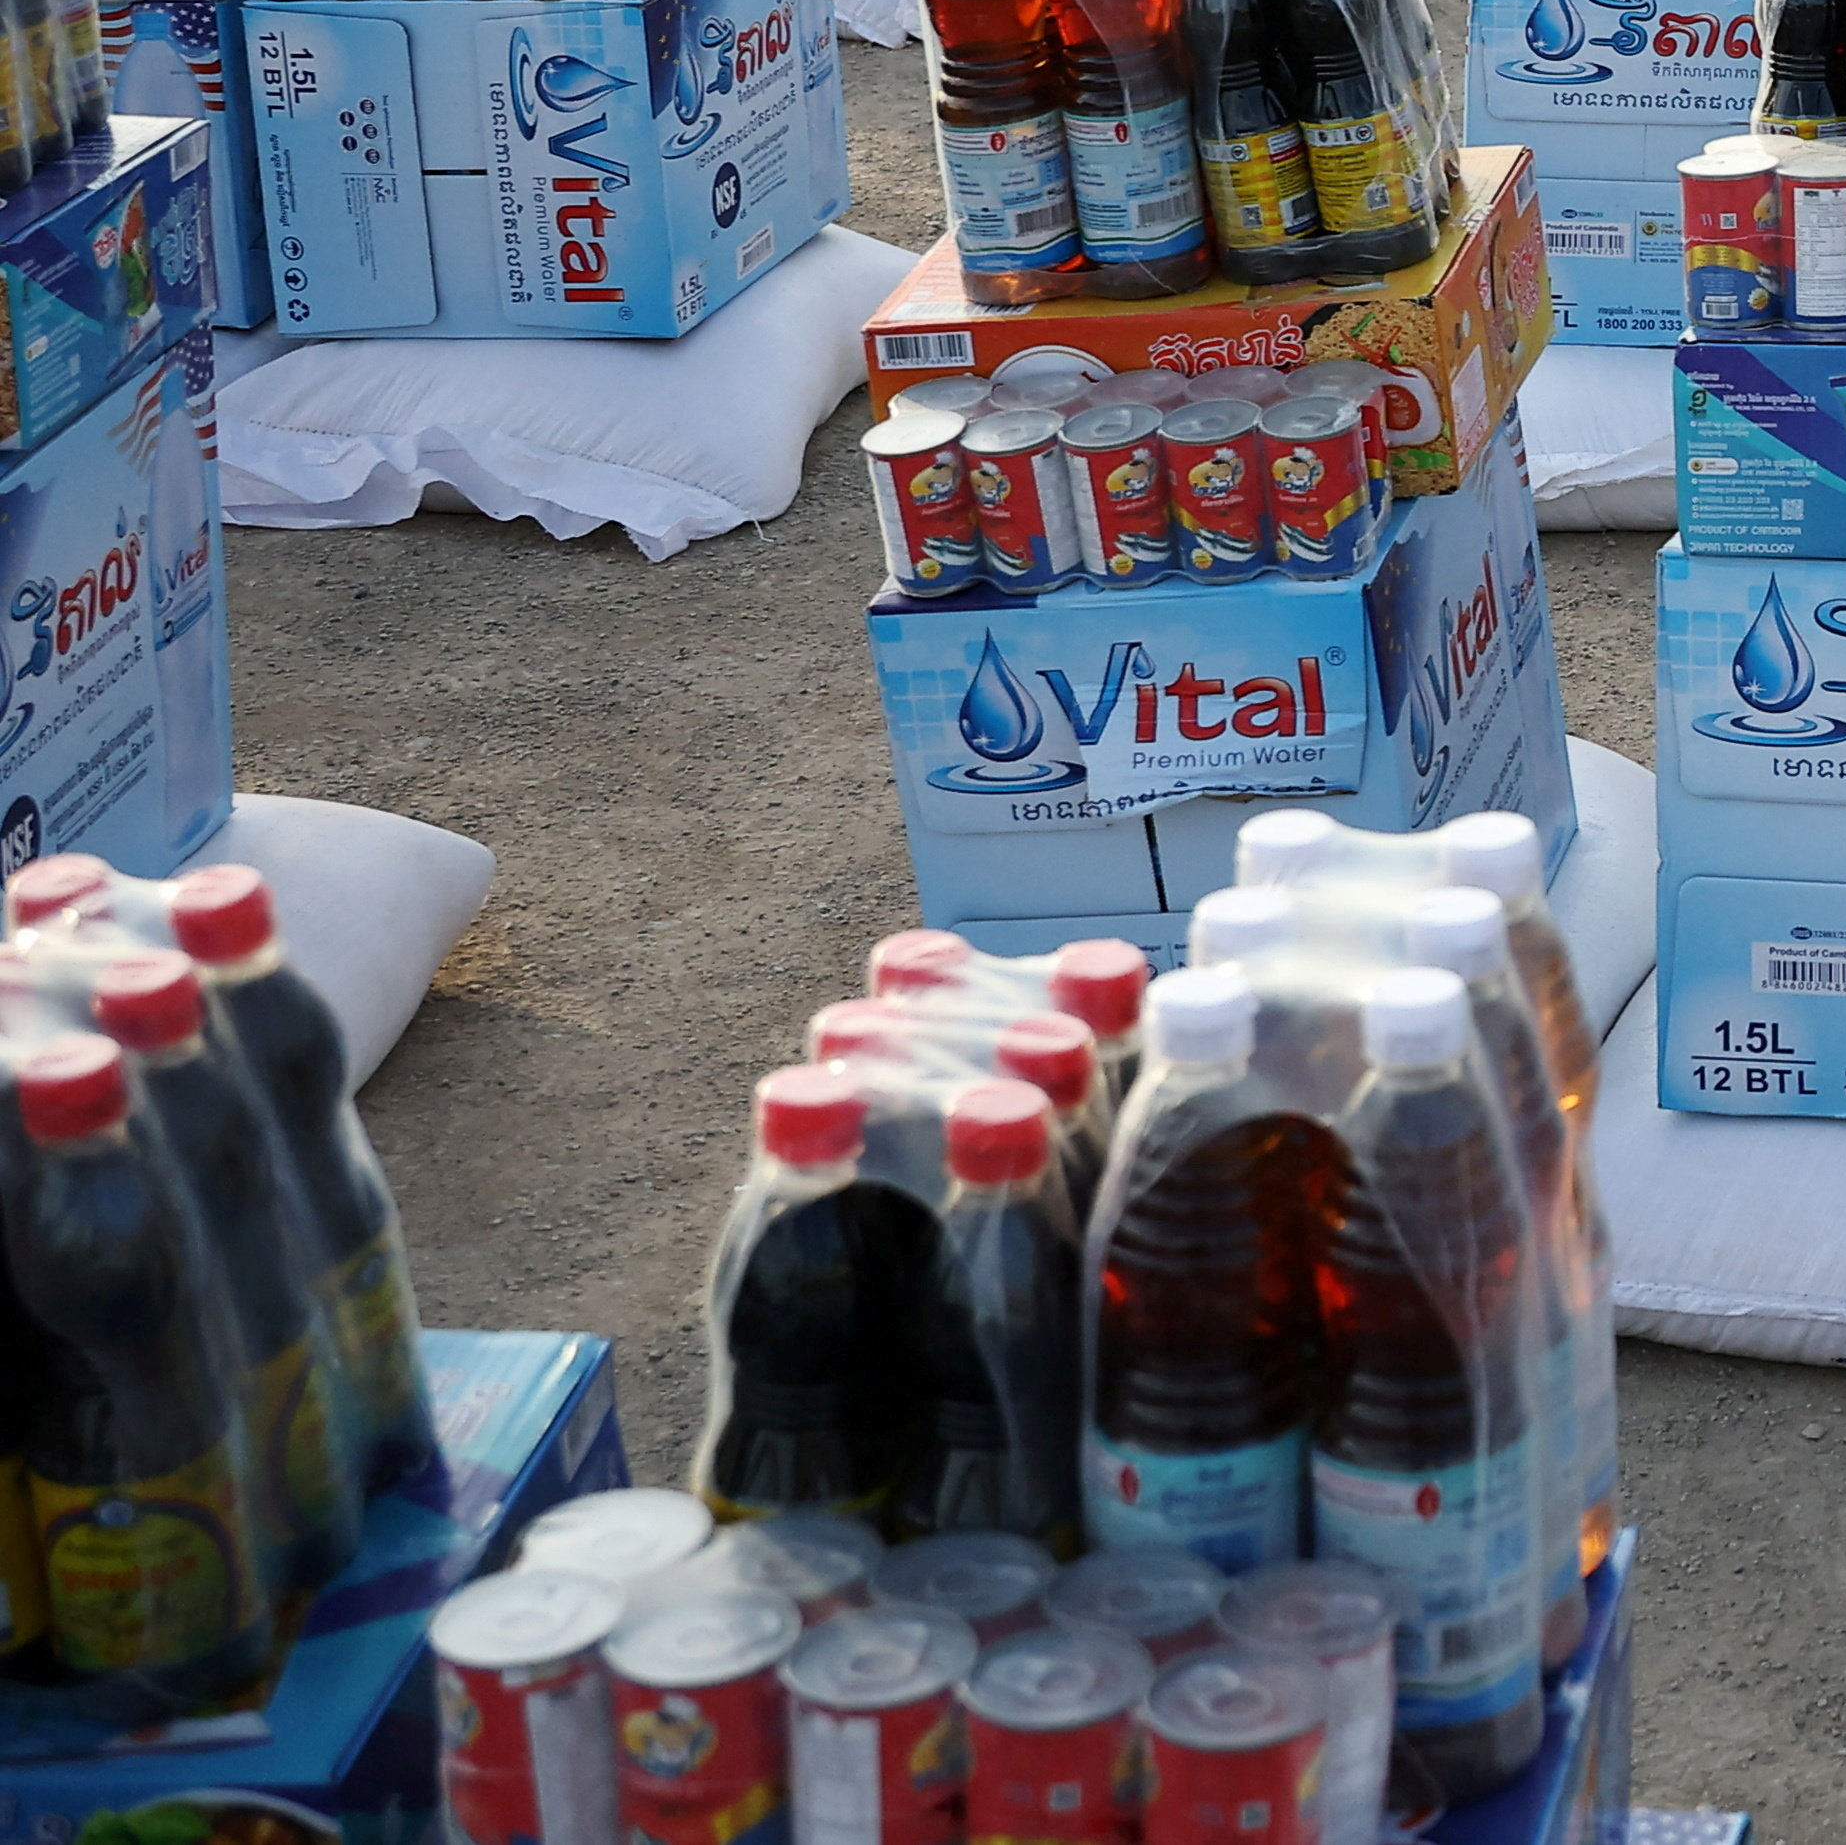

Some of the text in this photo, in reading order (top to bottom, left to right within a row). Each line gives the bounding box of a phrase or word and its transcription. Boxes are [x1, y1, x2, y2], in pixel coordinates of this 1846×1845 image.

[259, 32, 280, 59] 12
[289, 46, 317, 105] 1.5L
[263, 68, 285, 118] BTL
[548, 110, 630, 304] Vital
[713, 176, 740, 214] NSF
[532, 176, 556, 304] Premium Water
[679, 273, 702, 298] 1.5L
[1595, 317, 1683, 333] 1800 200 333
[1735, 525, 1748, 534] OF
[1724, 542, 1794, 554] TECHNOLOGY
[1036, 641, 1327, 745] Vital
[1132, 744, 1326, 770] Premium Water
[1768, 946, 1806, 958] Product
[1714, 1020, 1796, 1055] 1.5L
[1692, 1066, 1818, 1096] 12 BTL
